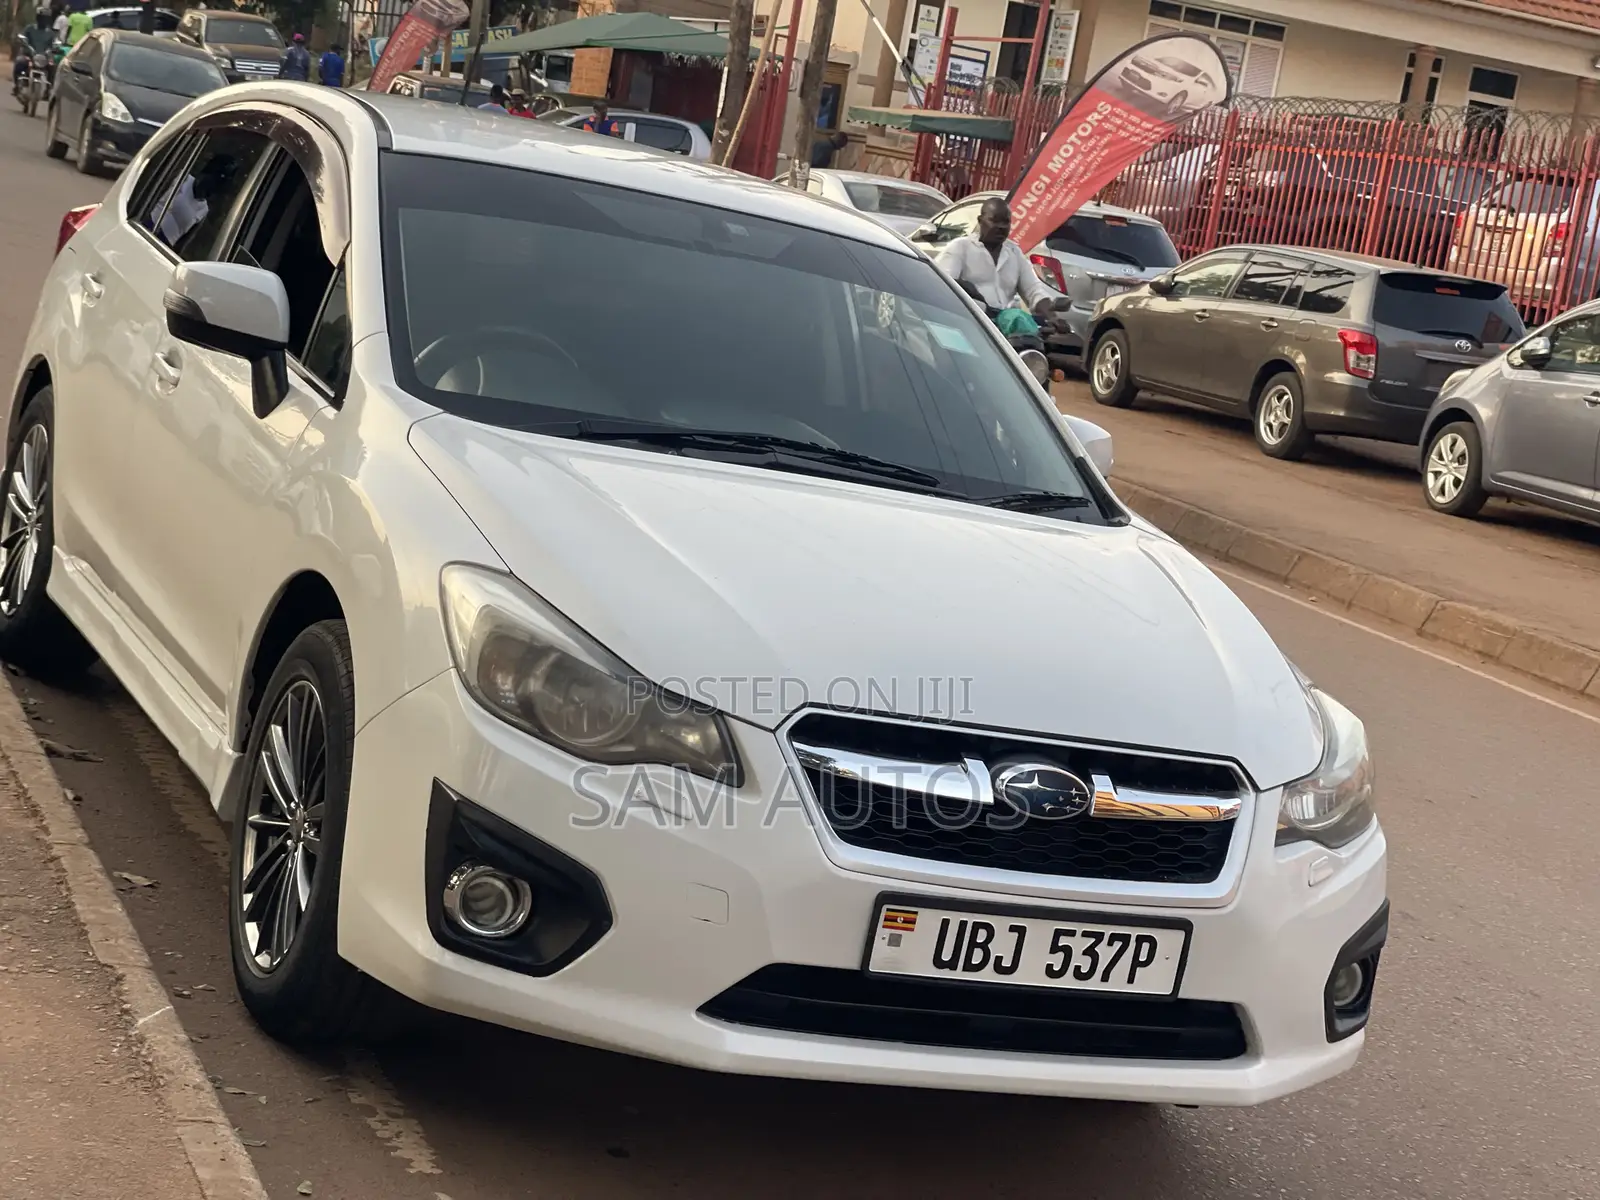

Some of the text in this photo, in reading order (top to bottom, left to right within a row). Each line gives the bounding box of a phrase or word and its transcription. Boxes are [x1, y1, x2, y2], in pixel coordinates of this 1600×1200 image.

[1010, 174, 1052, 234] LUNGI
[1047, 101, 1112, 175] MOTORS
[1013, 225, 1031, 245] New
[1036, 192, 1053, 215] used
[1051, 153, 1083, 195] Japanese
[1081, 134, 1101, 152] Cars
[932, 917, 1158, 985] UBJ 537P
